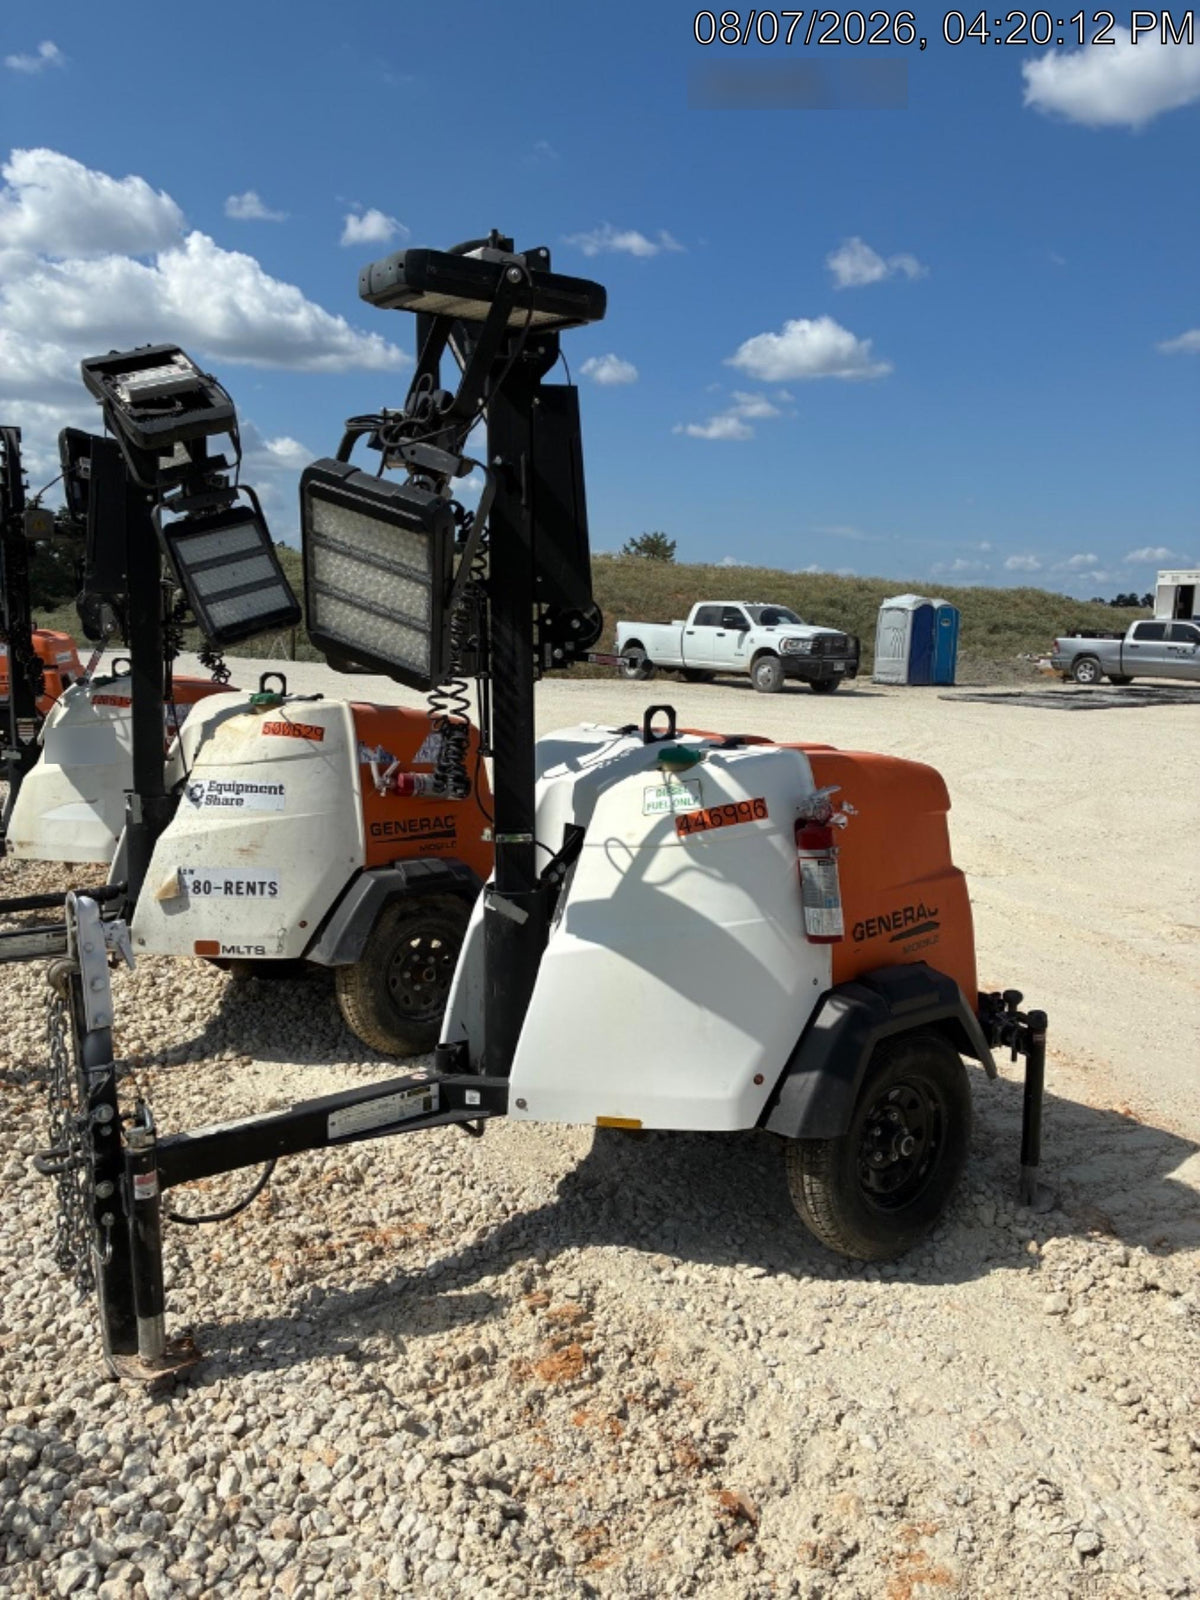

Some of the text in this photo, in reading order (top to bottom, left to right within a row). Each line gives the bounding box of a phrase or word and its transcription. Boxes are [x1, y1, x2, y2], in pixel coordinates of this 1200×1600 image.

[207, 780, 285, 796] Equipment
[205, 794, 244, 806] Share
[677, 797, 767, 833] 446996
[370, 815, 455, 837] GENERAC
